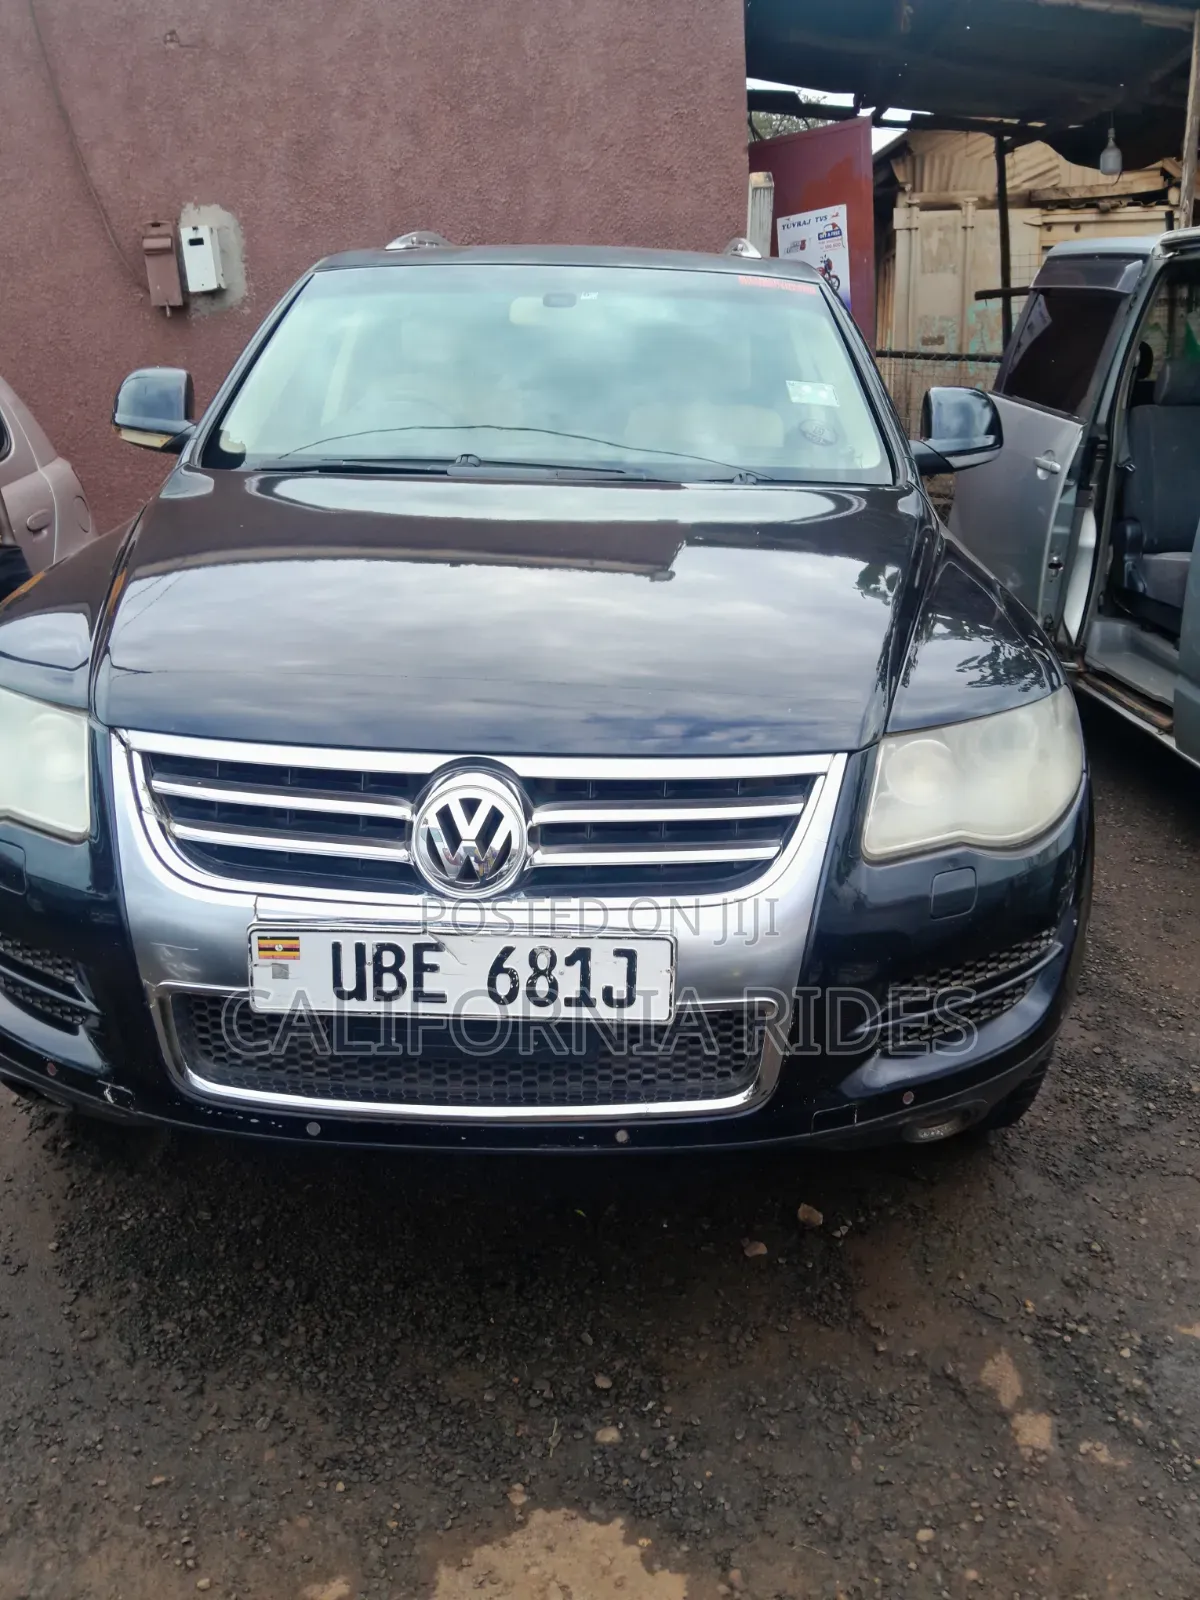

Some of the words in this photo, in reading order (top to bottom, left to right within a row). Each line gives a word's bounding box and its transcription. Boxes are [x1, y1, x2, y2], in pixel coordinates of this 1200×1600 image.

[782, 219, 811, 231] YUVRAJ
[815, 215, 828, 223] TVS
[331, 941, 448, 1003] UBE
[487, 945, 638, 1009] 681J
